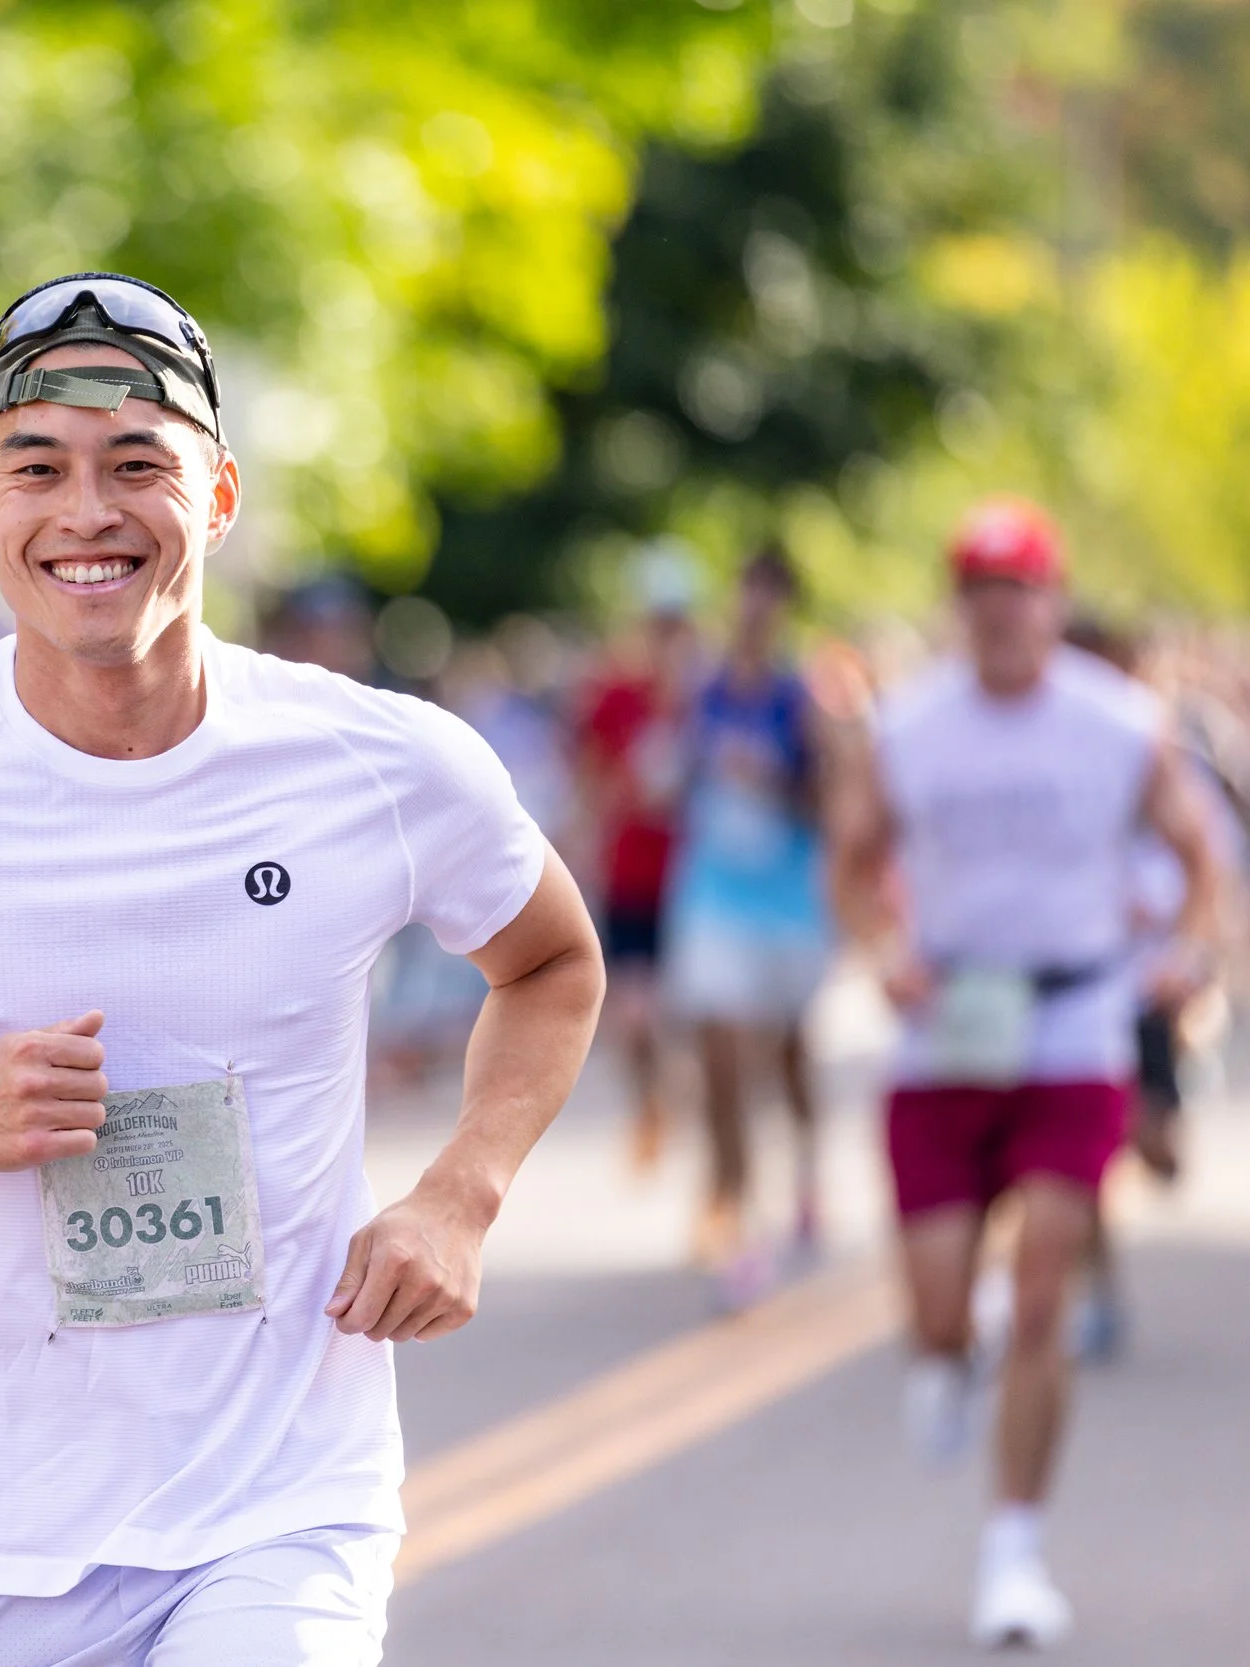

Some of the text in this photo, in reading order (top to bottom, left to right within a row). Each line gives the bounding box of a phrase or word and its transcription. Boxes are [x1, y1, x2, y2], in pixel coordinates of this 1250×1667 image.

[96, 1115, 178, 1139] BOULDERTHON
[110, 1150, 184, 1169] lululemon VIP
[126, 1169, 165, 1196] 10K
[66, 1195, 225, 1252] 30361
[185, 1260, 241, 1284] PUMA
